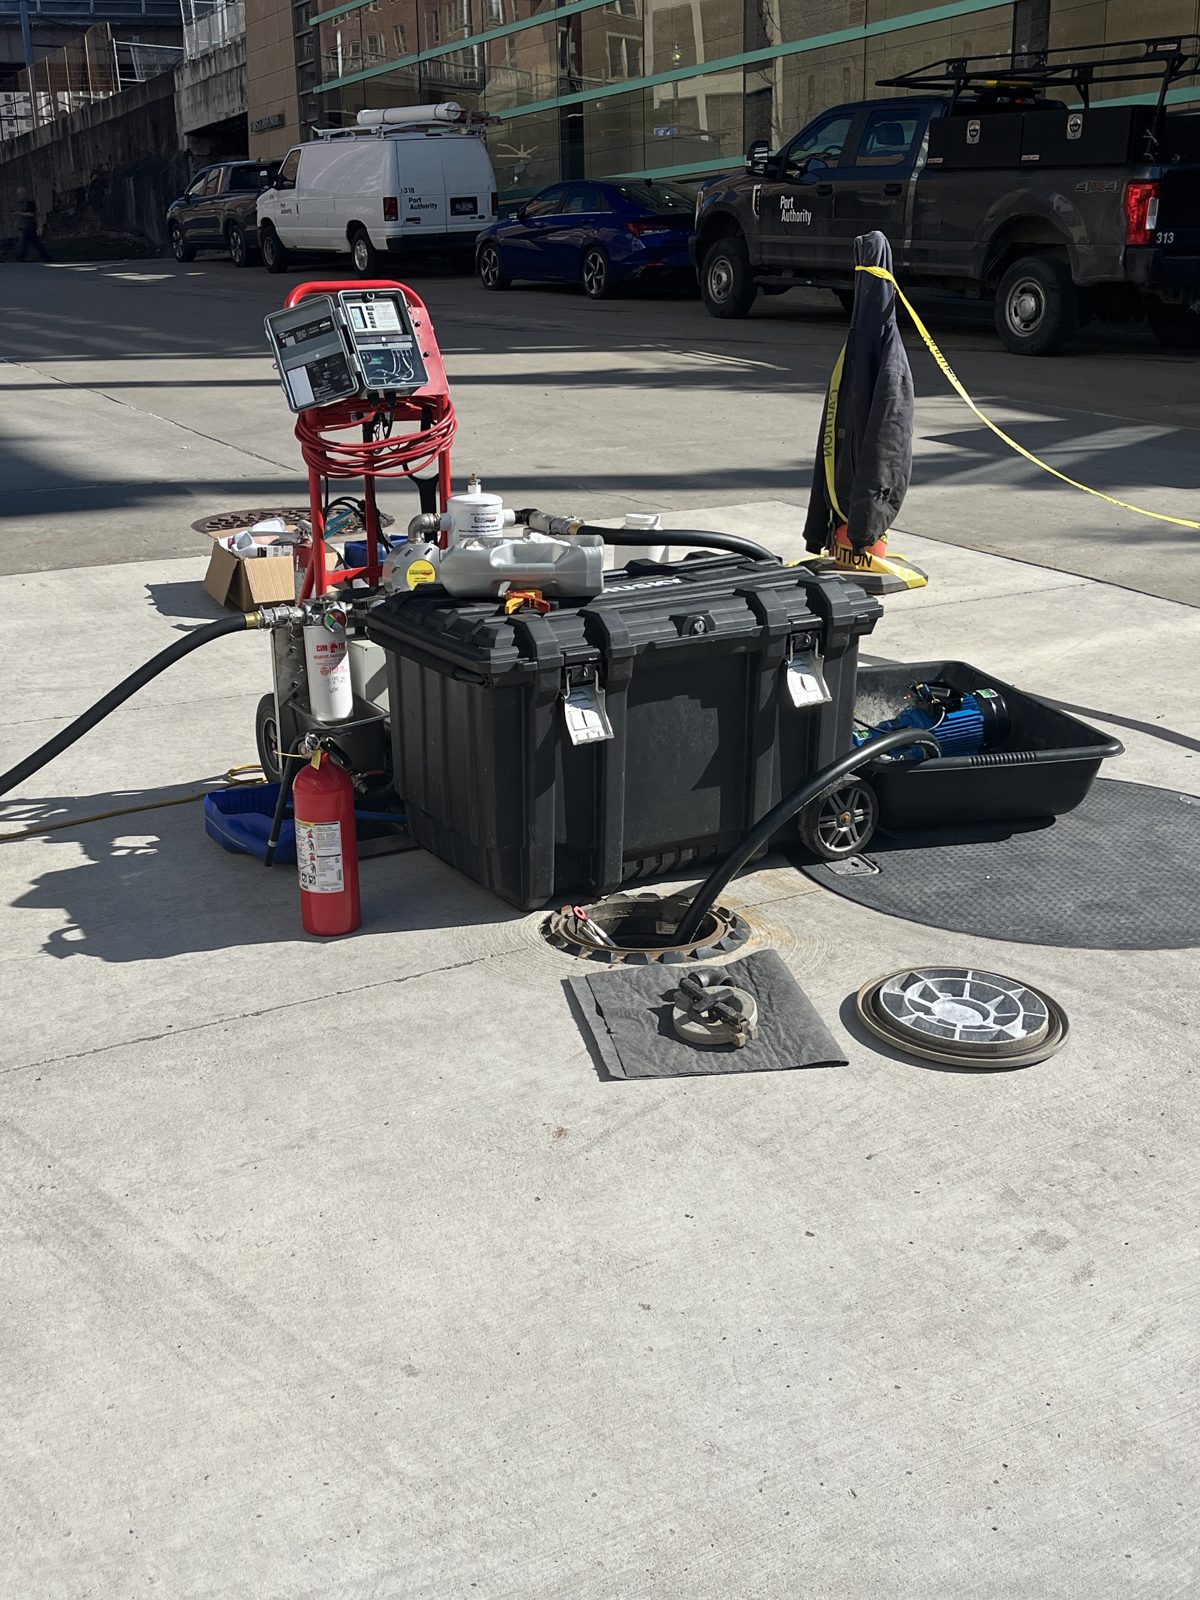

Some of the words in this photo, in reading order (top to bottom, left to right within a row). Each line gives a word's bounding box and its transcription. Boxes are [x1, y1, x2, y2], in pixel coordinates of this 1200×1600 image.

[780, 195, 794, 209] Port
[780, 208, 812, 226] Authority
[1155, 231, 1175, 244] 313
[835, 545, 872, 567] UTION
